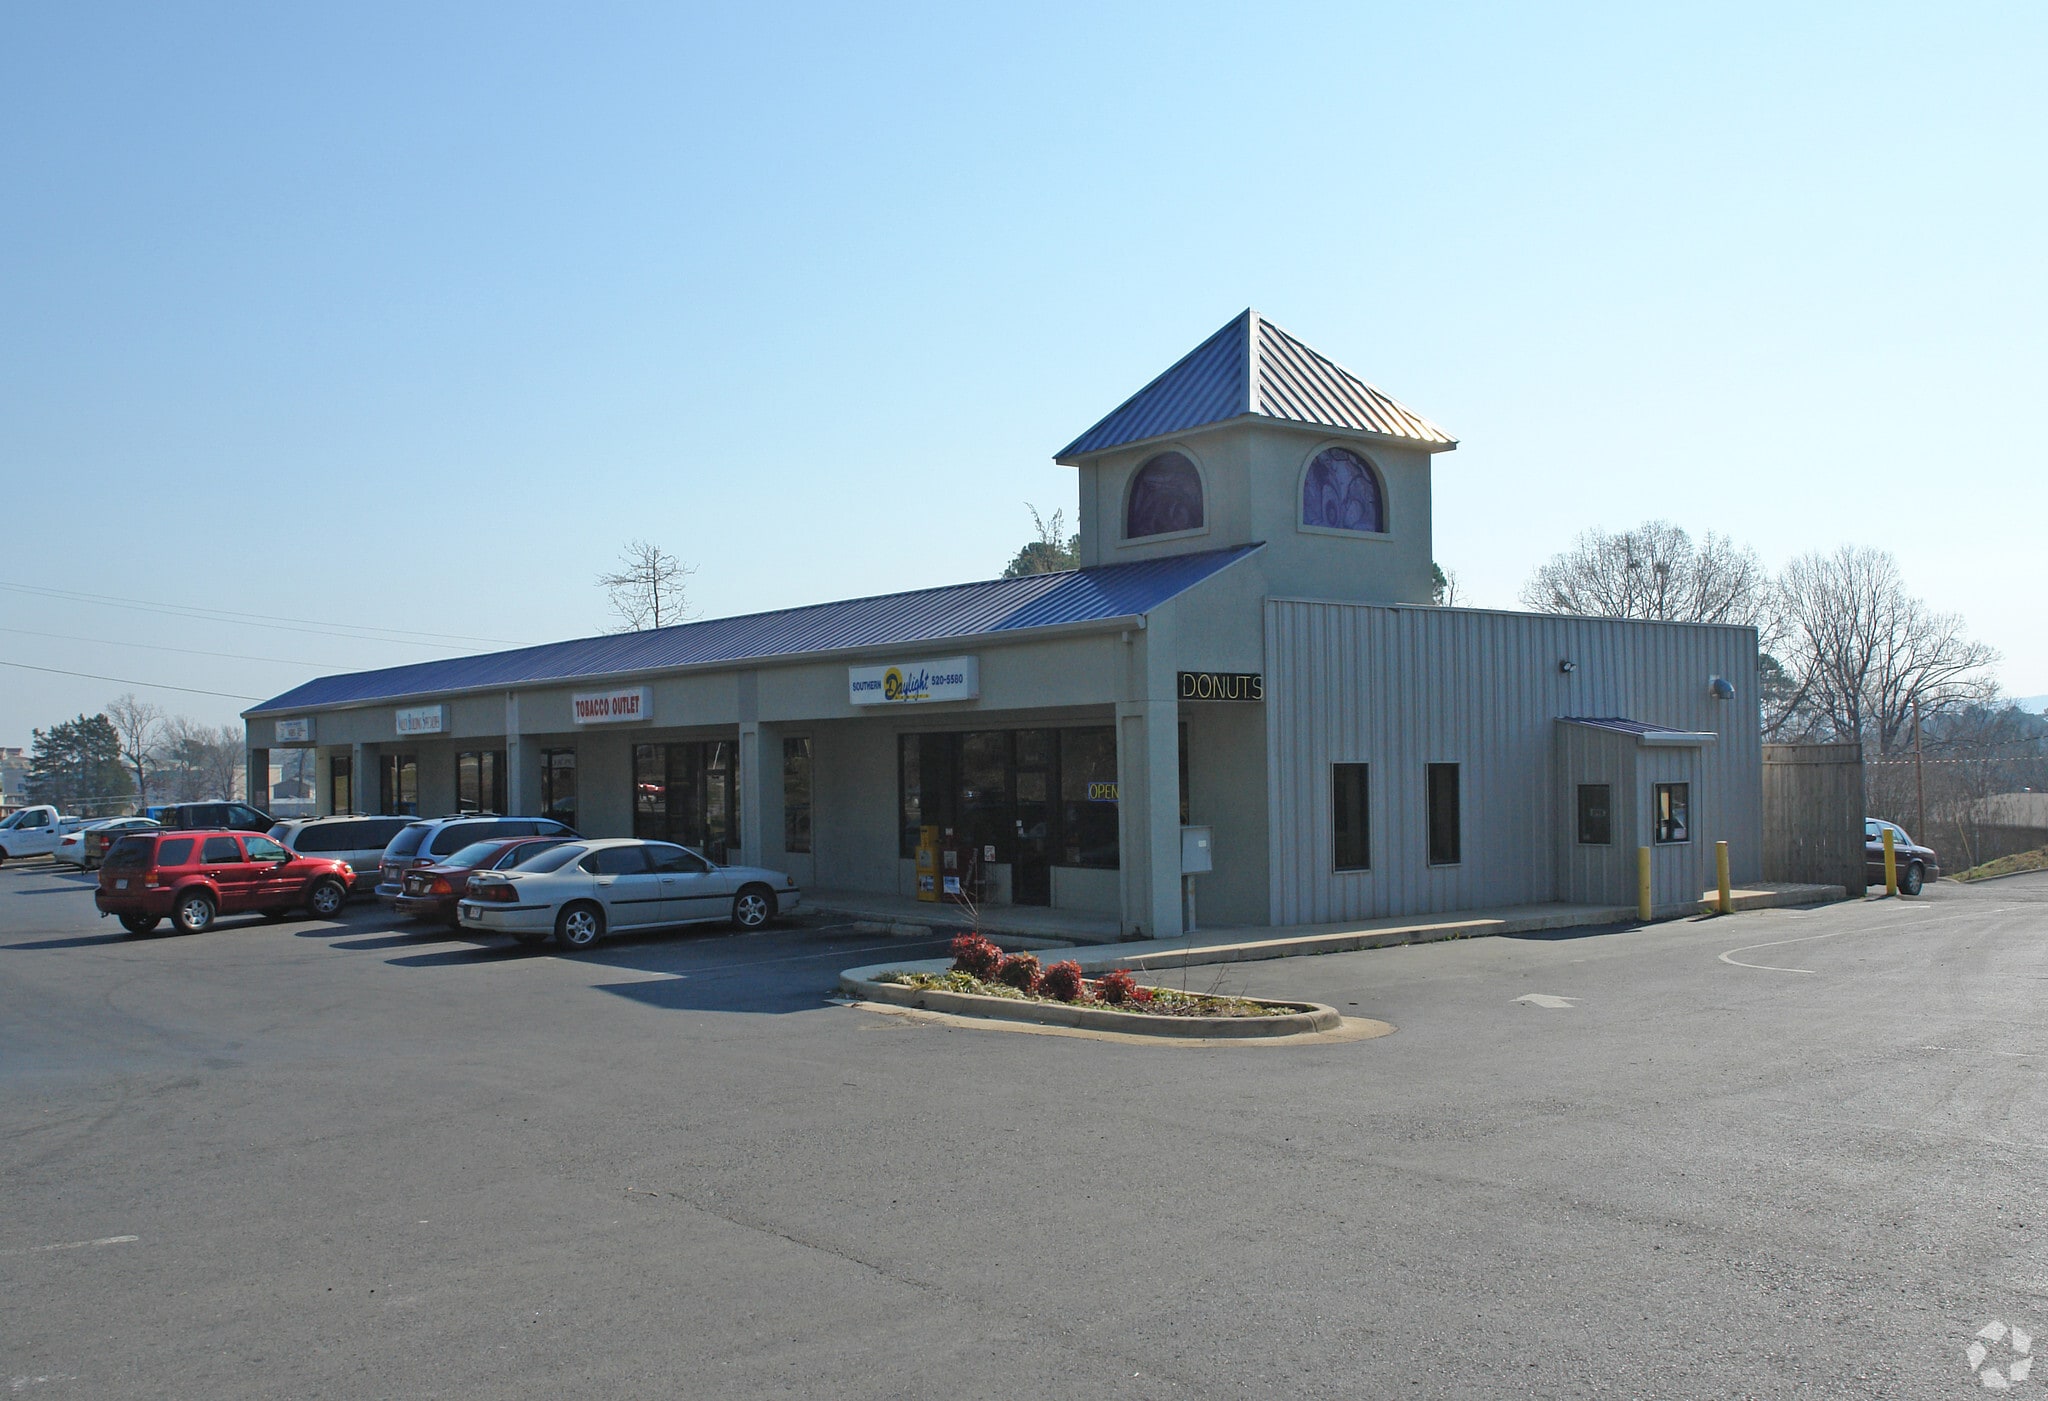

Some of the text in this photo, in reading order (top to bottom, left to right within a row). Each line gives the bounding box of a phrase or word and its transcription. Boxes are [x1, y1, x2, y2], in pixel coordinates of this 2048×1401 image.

[852, 680, 882, 692] SOUTHERN
[884, 668, 930, 702] Daylight
[931, 674, 963, 686] 520-5580
[1182, 673, 1264, 699] DONUTS
[575, 695, 640, 717] TOBACCO OUTLET
[1090, 783, 1119, 800] OPEN
